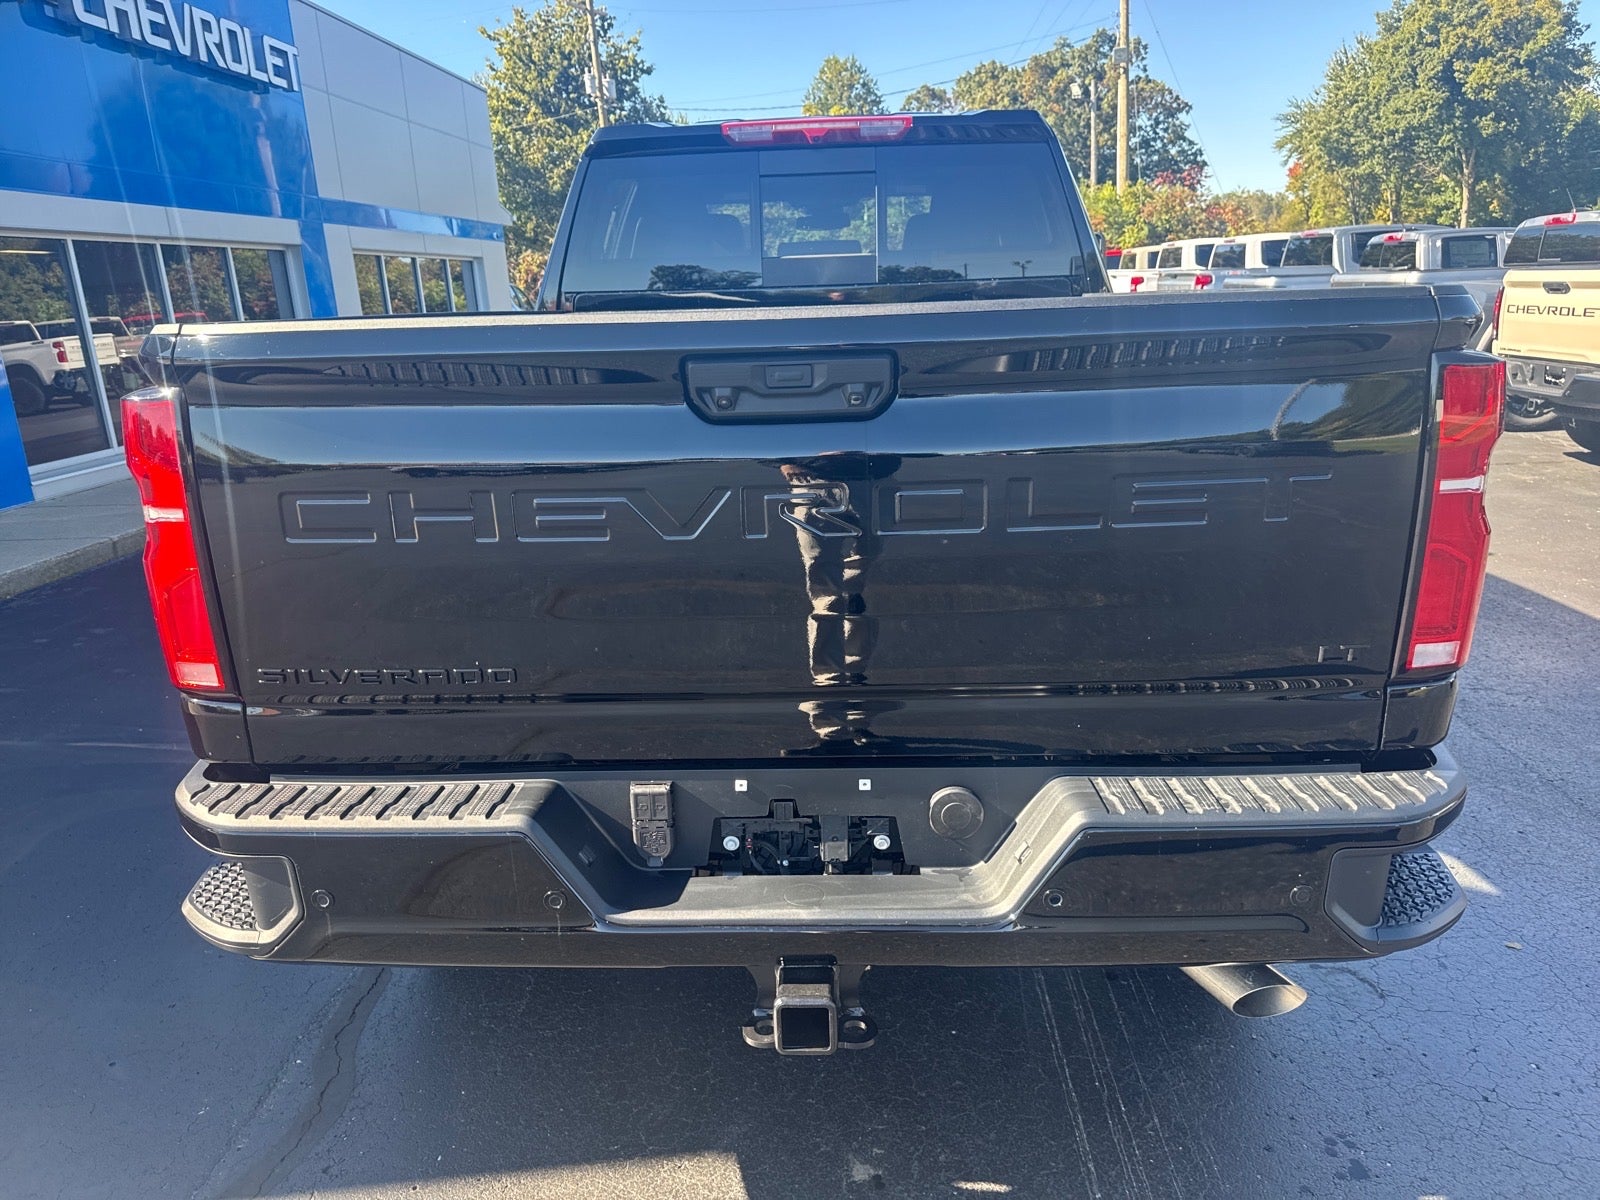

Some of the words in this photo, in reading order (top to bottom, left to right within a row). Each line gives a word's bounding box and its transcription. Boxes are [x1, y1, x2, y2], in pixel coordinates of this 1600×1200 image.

[1507, 304, 1600, 317] CHEVROLE
[278, 469, 1333, 543] CHEVROLET
[1317, 644, 1370, 664] LT
[257, 667, 518, 685] SILVERADO
